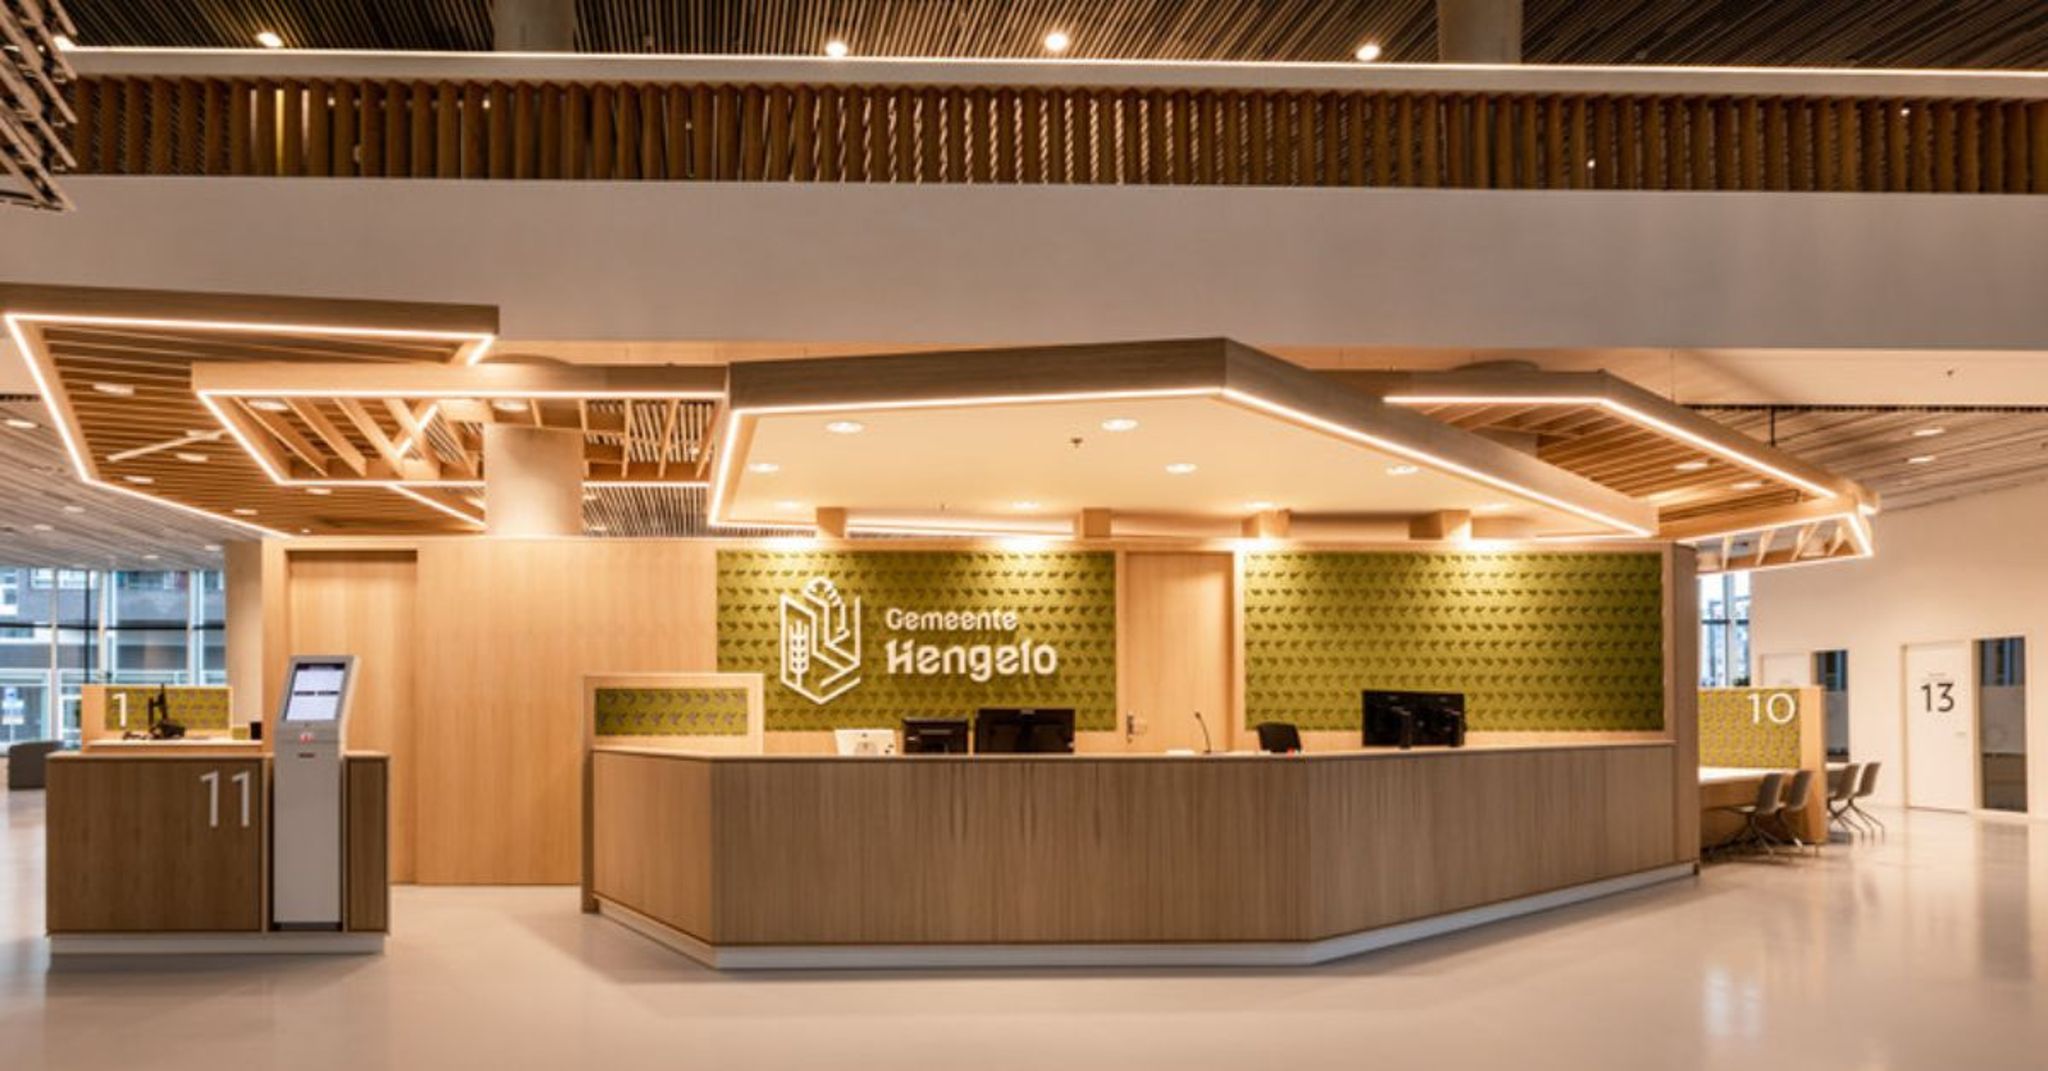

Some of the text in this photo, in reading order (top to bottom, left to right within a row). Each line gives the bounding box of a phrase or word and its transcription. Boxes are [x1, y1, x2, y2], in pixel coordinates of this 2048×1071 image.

[886, 608, 1018, 631] Gemeente
[885, 639, 1058, 682] Hengelo
[112, 692, 127, 727] 1
[1747, 692, 1796, 724] 10
[1921, 682, 1955, 712] 13
[200, 770, 250, 828] 11
